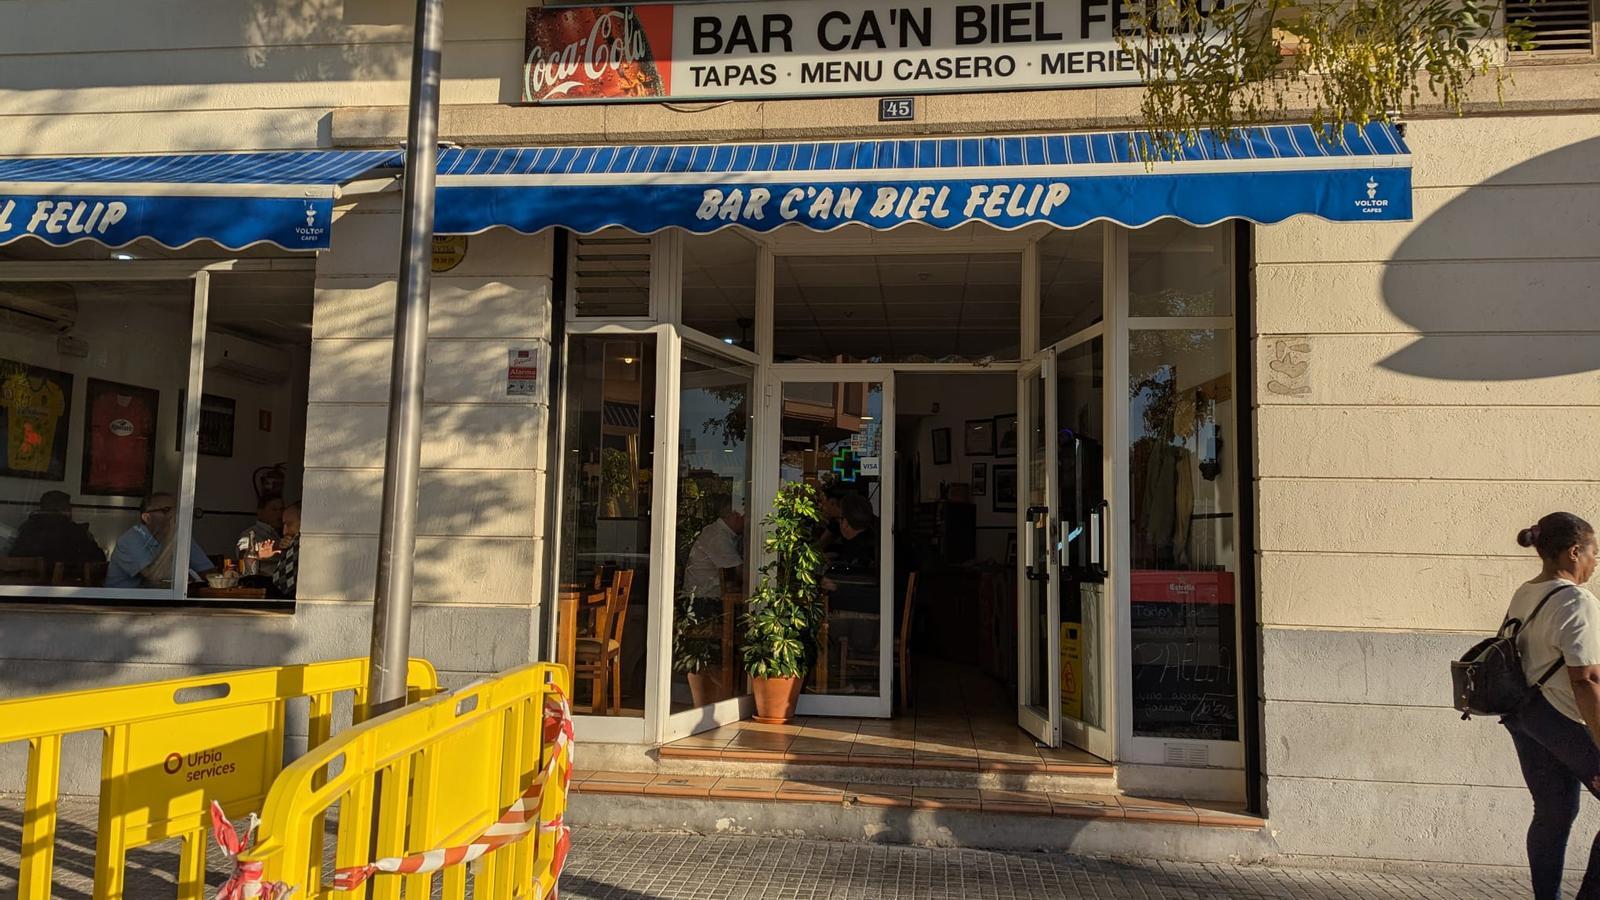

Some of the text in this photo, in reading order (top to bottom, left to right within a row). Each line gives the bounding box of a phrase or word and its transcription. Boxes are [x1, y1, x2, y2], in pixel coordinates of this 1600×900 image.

[693, 13, 793, 56] BAR
[817, 7, 932, 51] CA'N
[955, 1, 1063, 46] BIEL
[525, 6, 646, 102] Coca-Cola
[690, 62, 777, 88] TAPAS
[801, 60, 883, 84] MENU
[893, 55, 1016, 81] CASERO
[886, 101, 910, 116] 45
[26, 200, 127, 234] FELIP
[695, 183, 1071, 221] BAR C'AN BIEL FELIP
[1354, 199, 1389, 207] VOLTOR
[186, 762, 236, 781] services
[187, 749, 222, 767] Urbia
